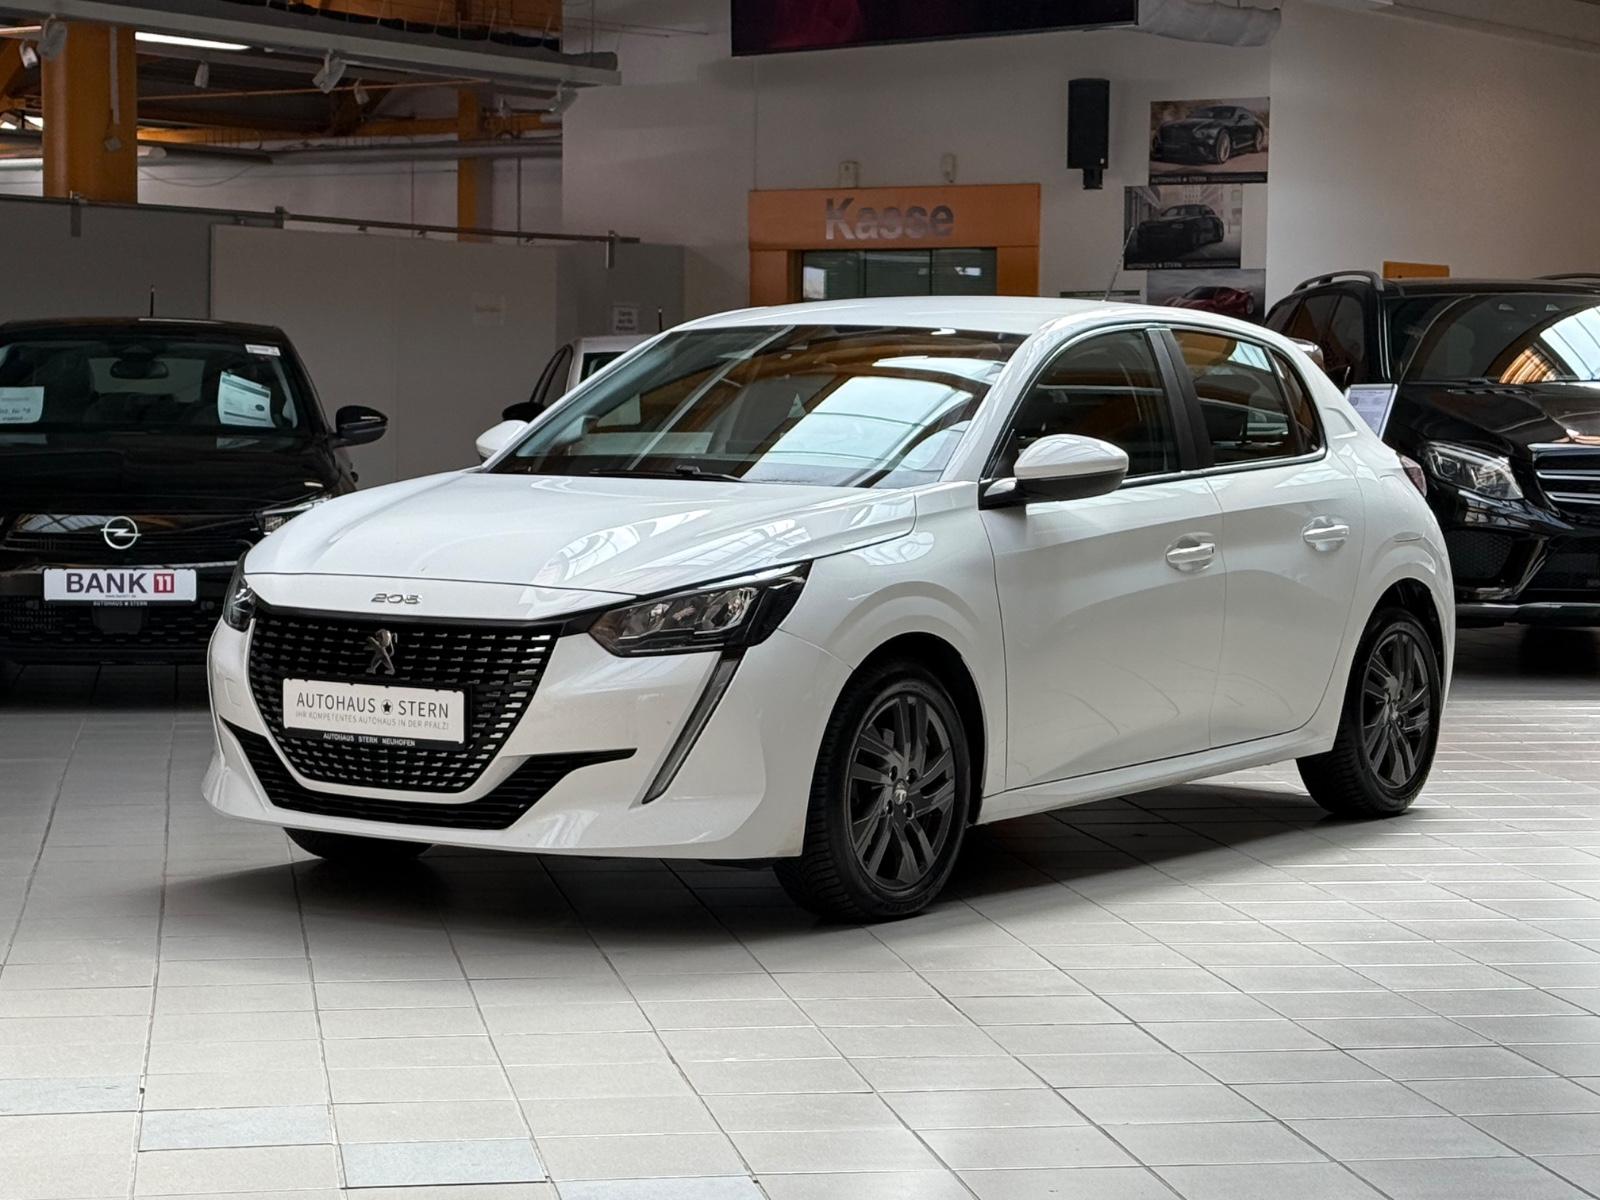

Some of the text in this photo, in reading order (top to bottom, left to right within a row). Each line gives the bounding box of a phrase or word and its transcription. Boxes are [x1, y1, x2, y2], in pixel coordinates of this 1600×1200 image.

[825, 197, 954, 240] Kasse
[66, 573, 172, 593] BANK 11
[297, 692, 449, 719] AUTOHAUS STERN
[309, 712, 357, 723] KOMPETENTES
[358, 715, 397, 727] AUTOHAUS
[398, 719, 406, 727] IN
[408, 720, 423, 728] DER
[323, 732, 416, 747] AUTOHAUS STERN NEUHOFEN
